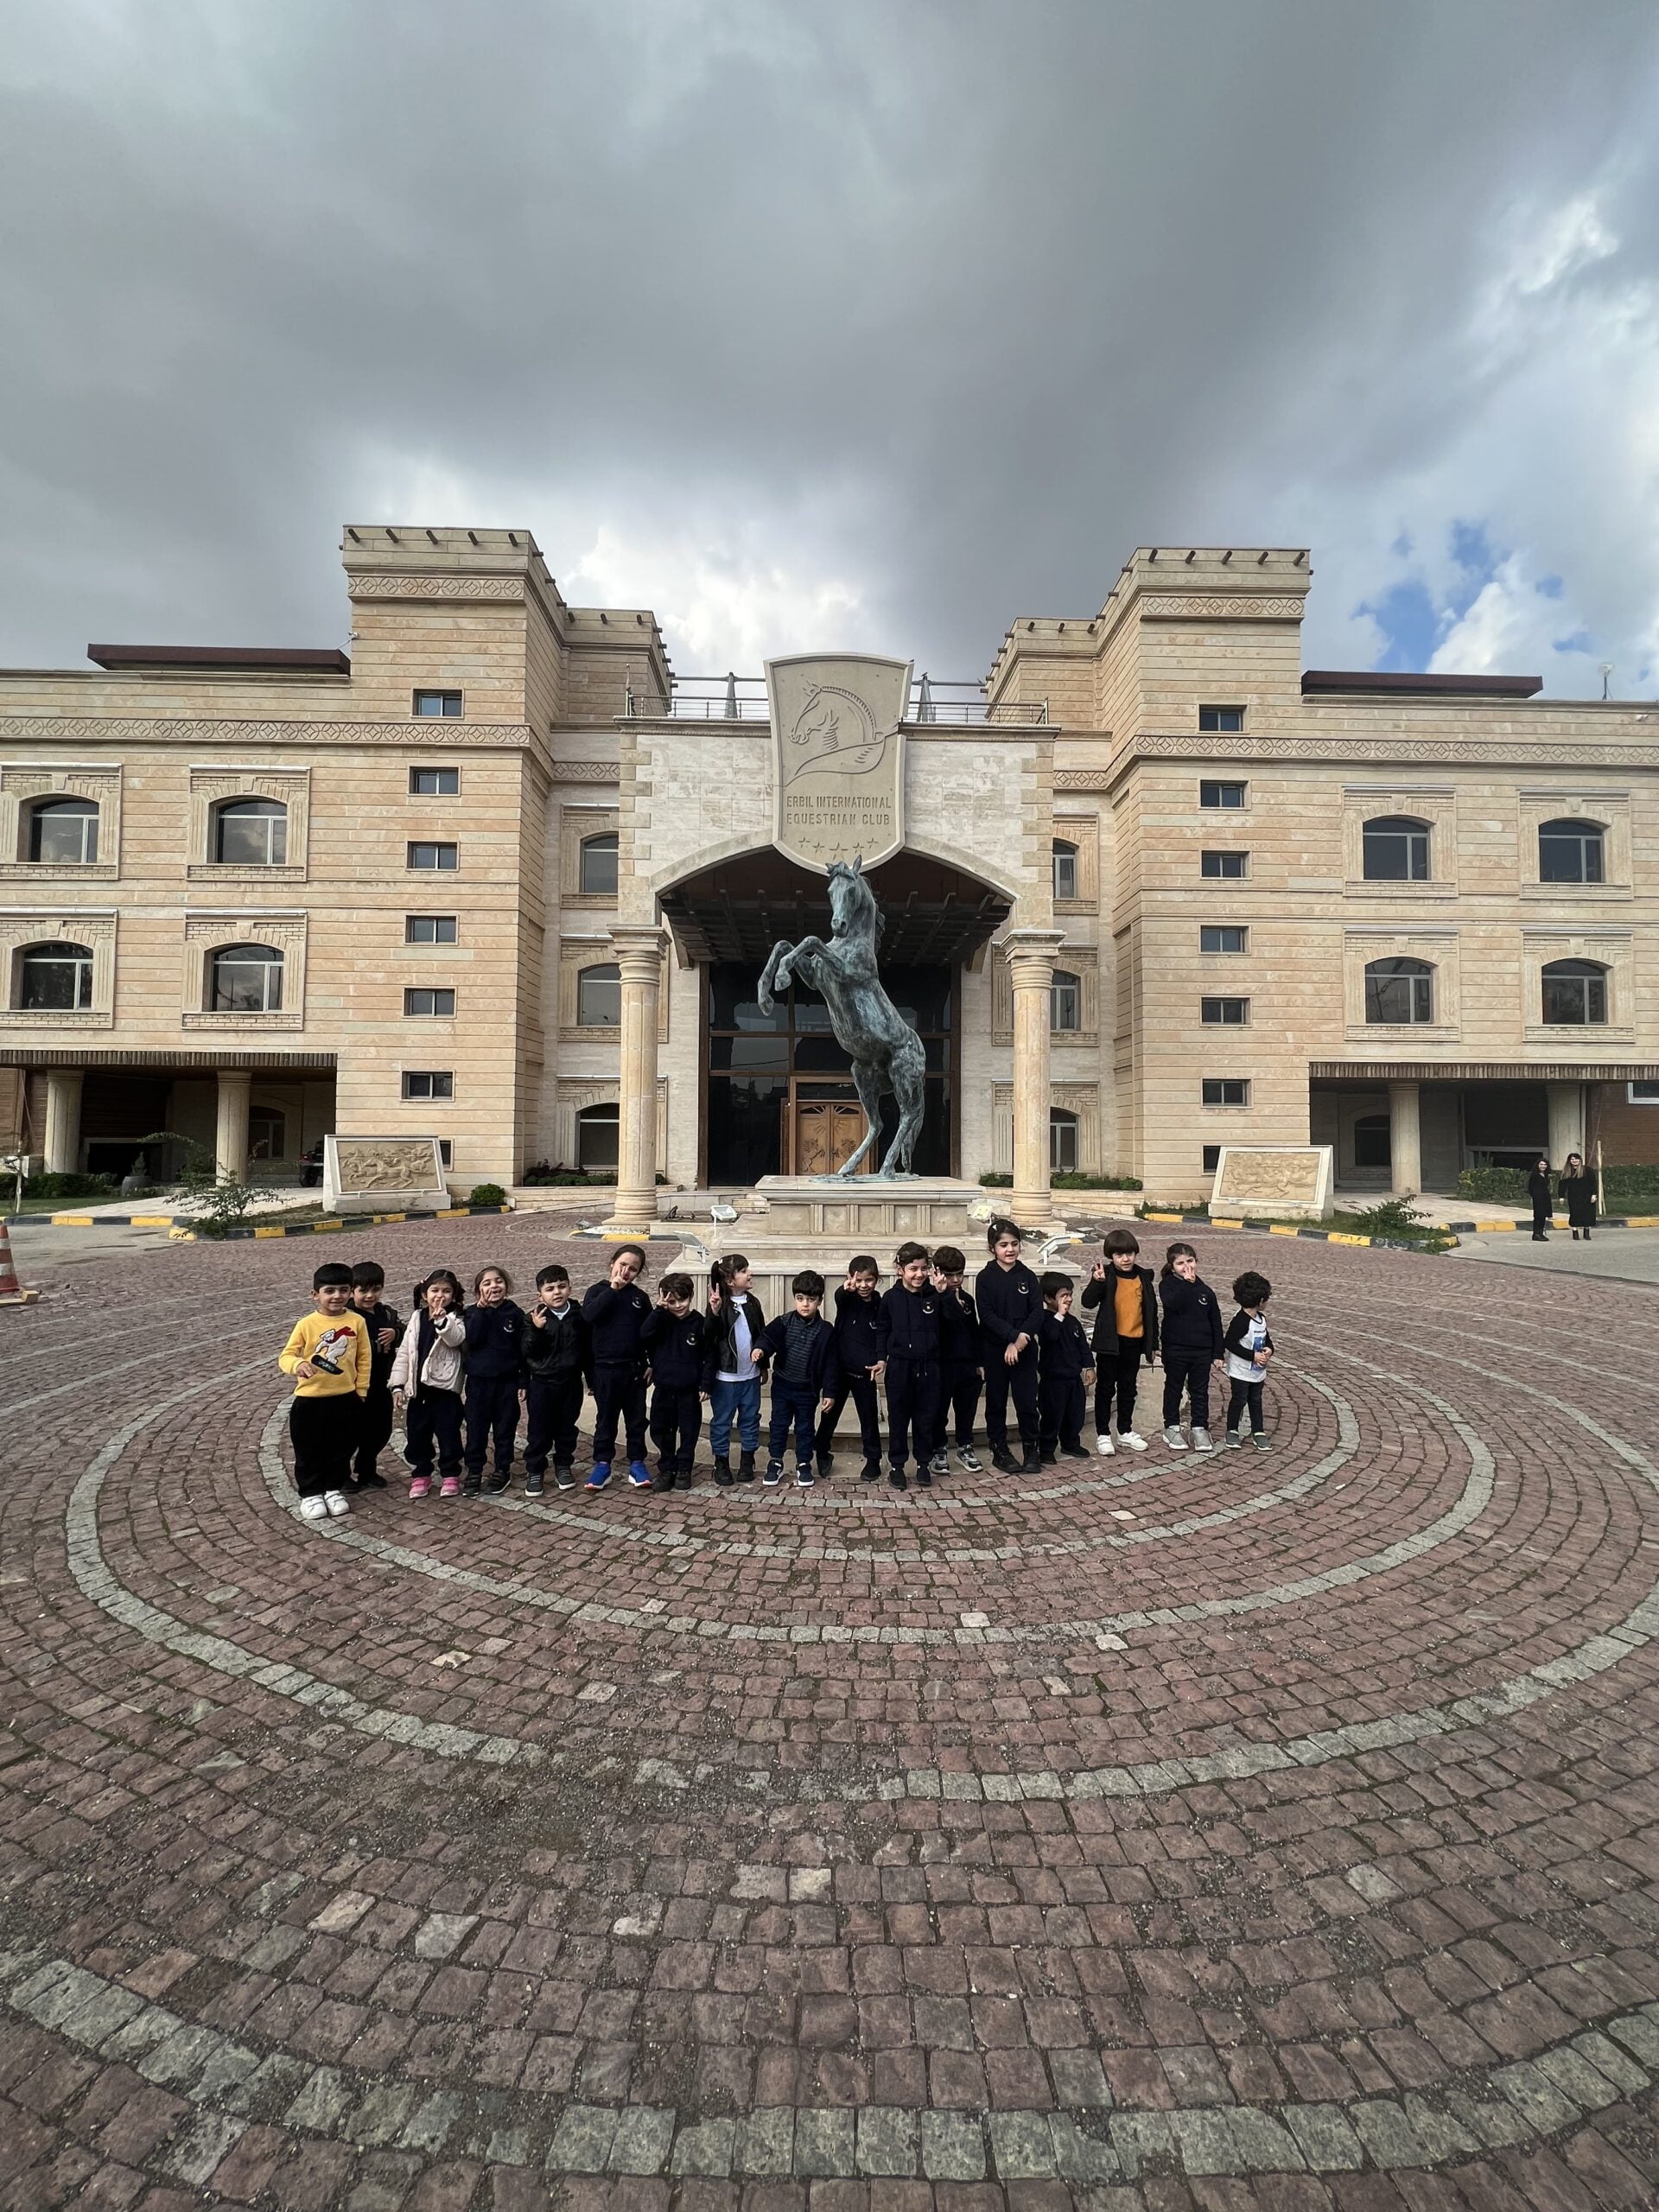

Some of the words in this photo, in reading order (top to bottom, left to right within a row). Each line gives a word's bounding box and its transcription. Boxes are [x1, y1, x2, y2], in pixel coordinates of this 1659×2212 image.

[786, 796, 814, 808] ERBIL
[817, 796, 892, 809] INTERNATIONAL
[786, 813, 855, 825] EQUESTRIAN
[861, 814, 890, 825] CLUB
